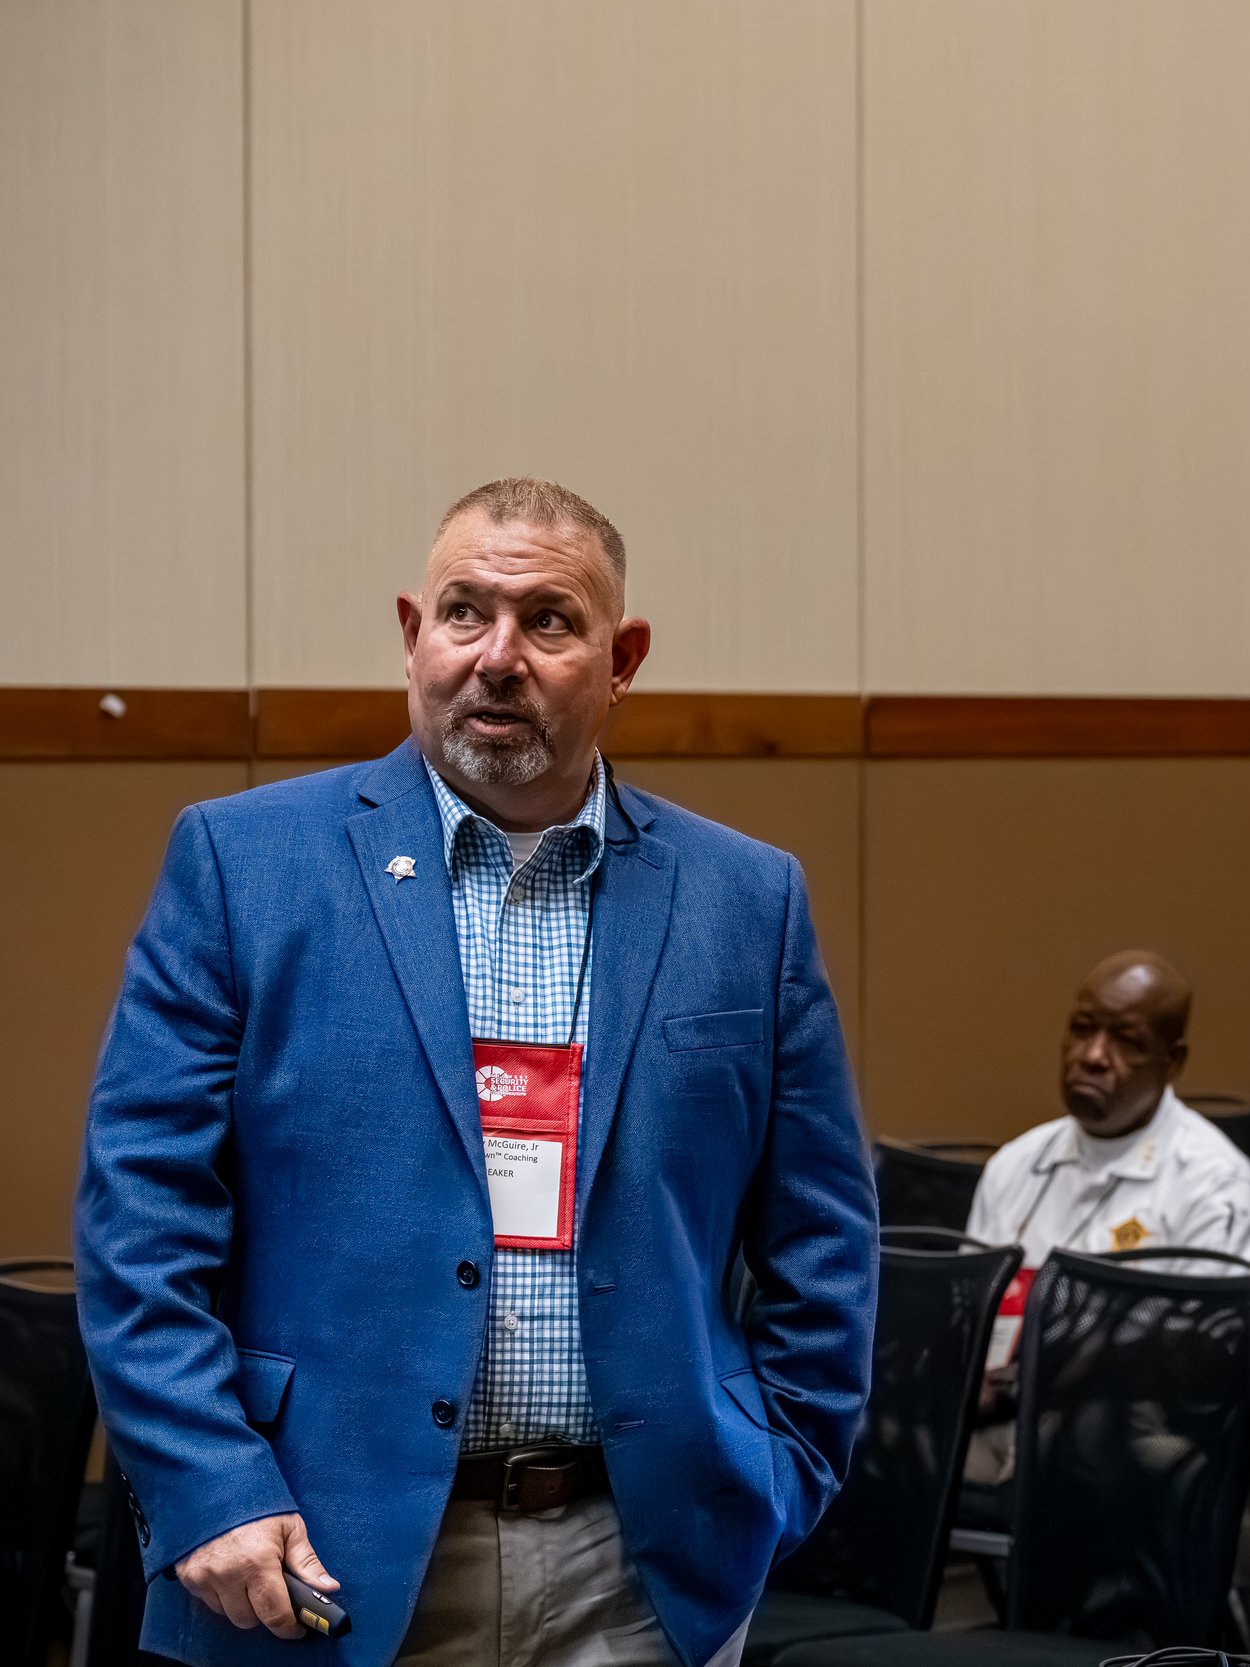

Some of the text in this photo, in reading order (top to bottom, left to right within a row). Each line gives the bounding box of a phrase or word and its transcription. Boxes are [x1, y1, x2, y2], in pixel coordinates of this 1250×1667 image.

[491, 1078, 528, 1086] SECURITY
[488, 1140, 528, 1150] McGuire,
[531, 1142, 539, 1150] Jr
[504, 1153, 538, 1163] Coaching
[488, 1168, 514, 1178] EAKER
